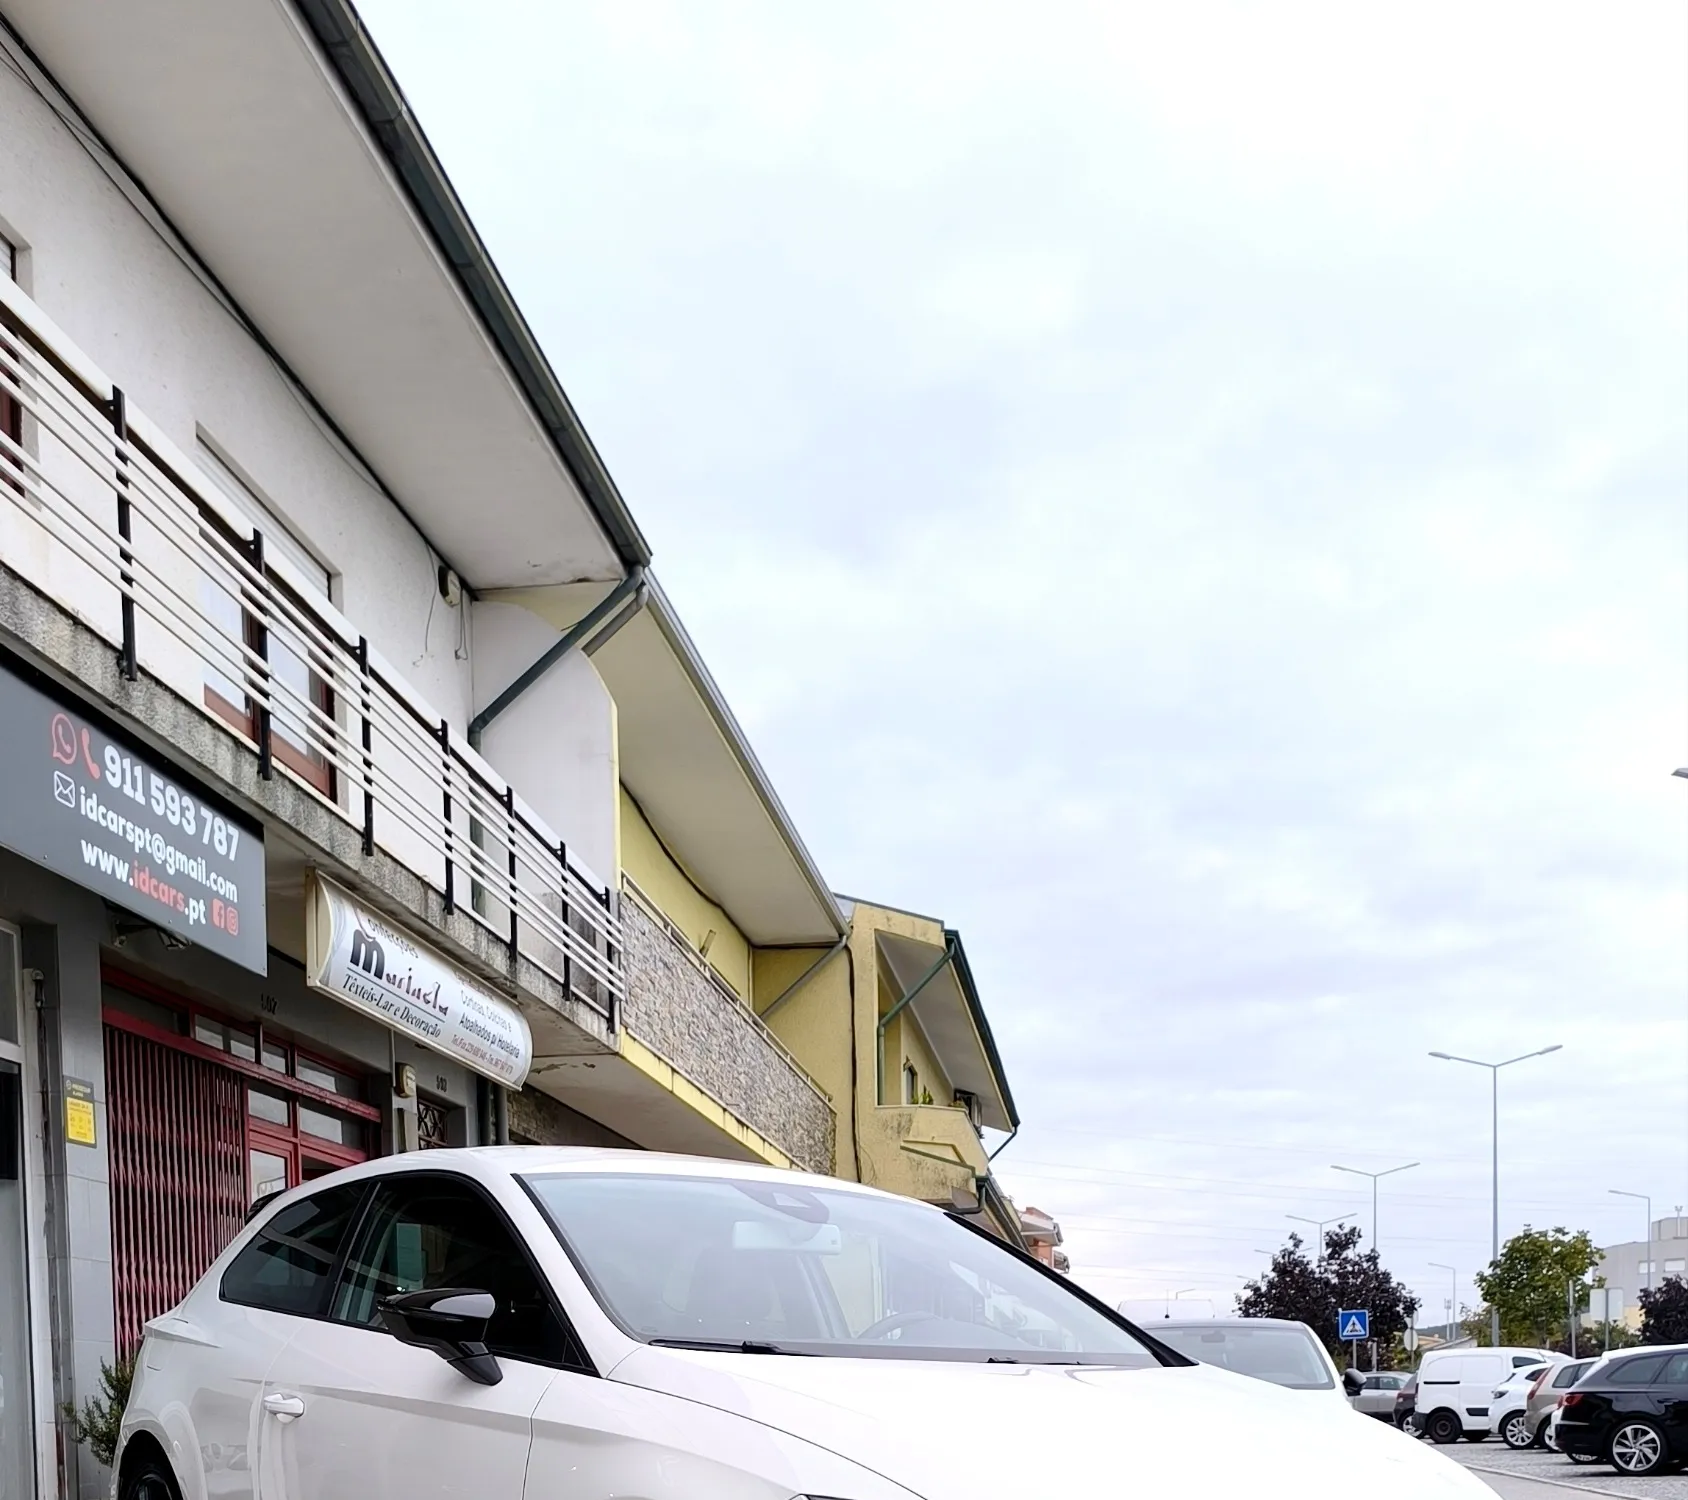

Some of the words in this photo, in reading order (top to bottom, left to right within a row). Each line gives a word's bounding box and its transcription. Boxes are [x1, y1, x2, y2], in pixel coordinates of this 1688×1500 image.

[79, 786, 238, 903] idcarspt@gmail.com
[104, 745, 146, 806] 911
[150, 773, 197, 836] 593
[200, 806, 240, 862] 787
[80, 839, 207, 925] www.idcars.pt
[400, 1004, 442, 1038] Decoração
